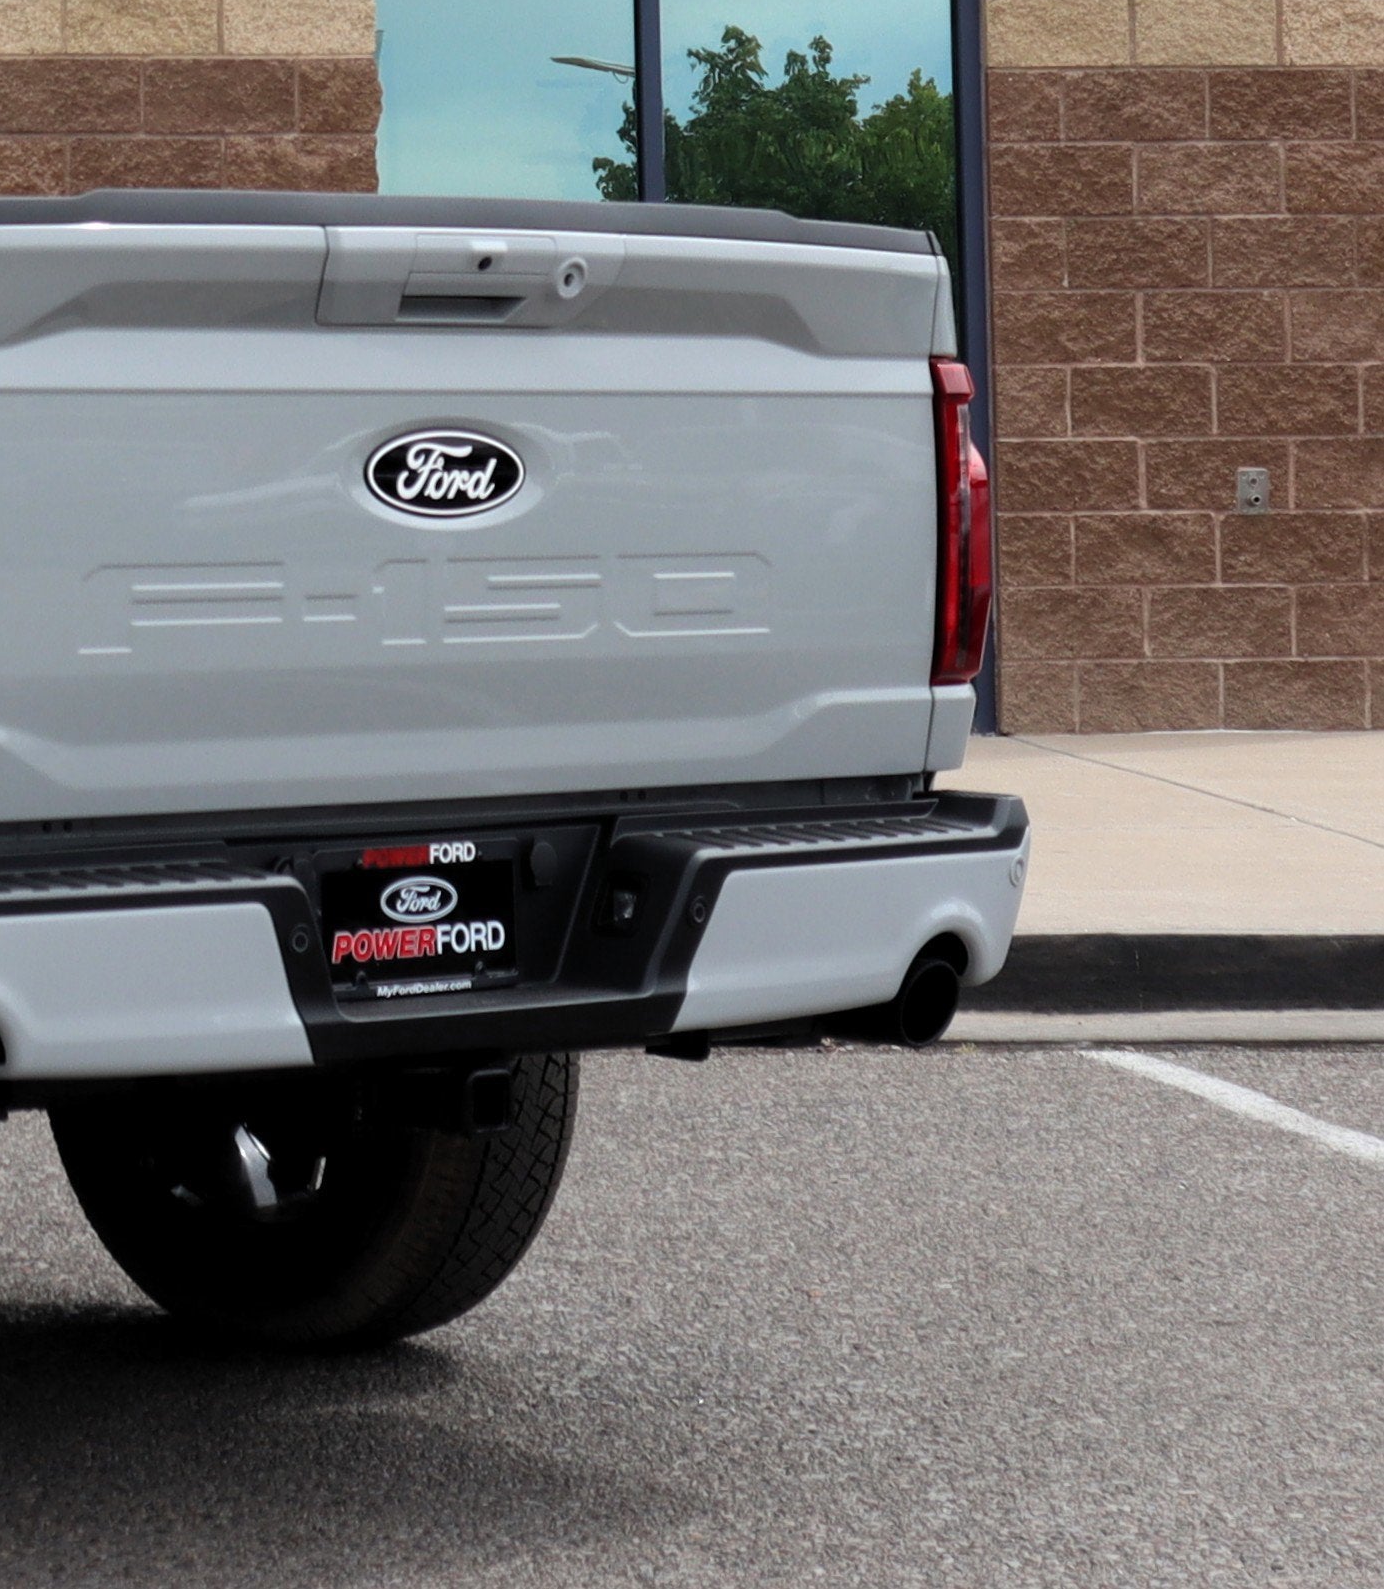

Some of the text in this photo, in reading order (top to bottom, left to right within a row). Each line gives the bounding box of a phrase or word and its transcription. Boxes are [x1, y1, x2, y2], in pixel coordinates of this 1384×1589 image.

[395, 442, 498, 501] Ford
[77, 553, 772, 655] F-150
[396, 886, 442, 912] Ford
[377, 980, 472, 998] MyFordDealer.com
